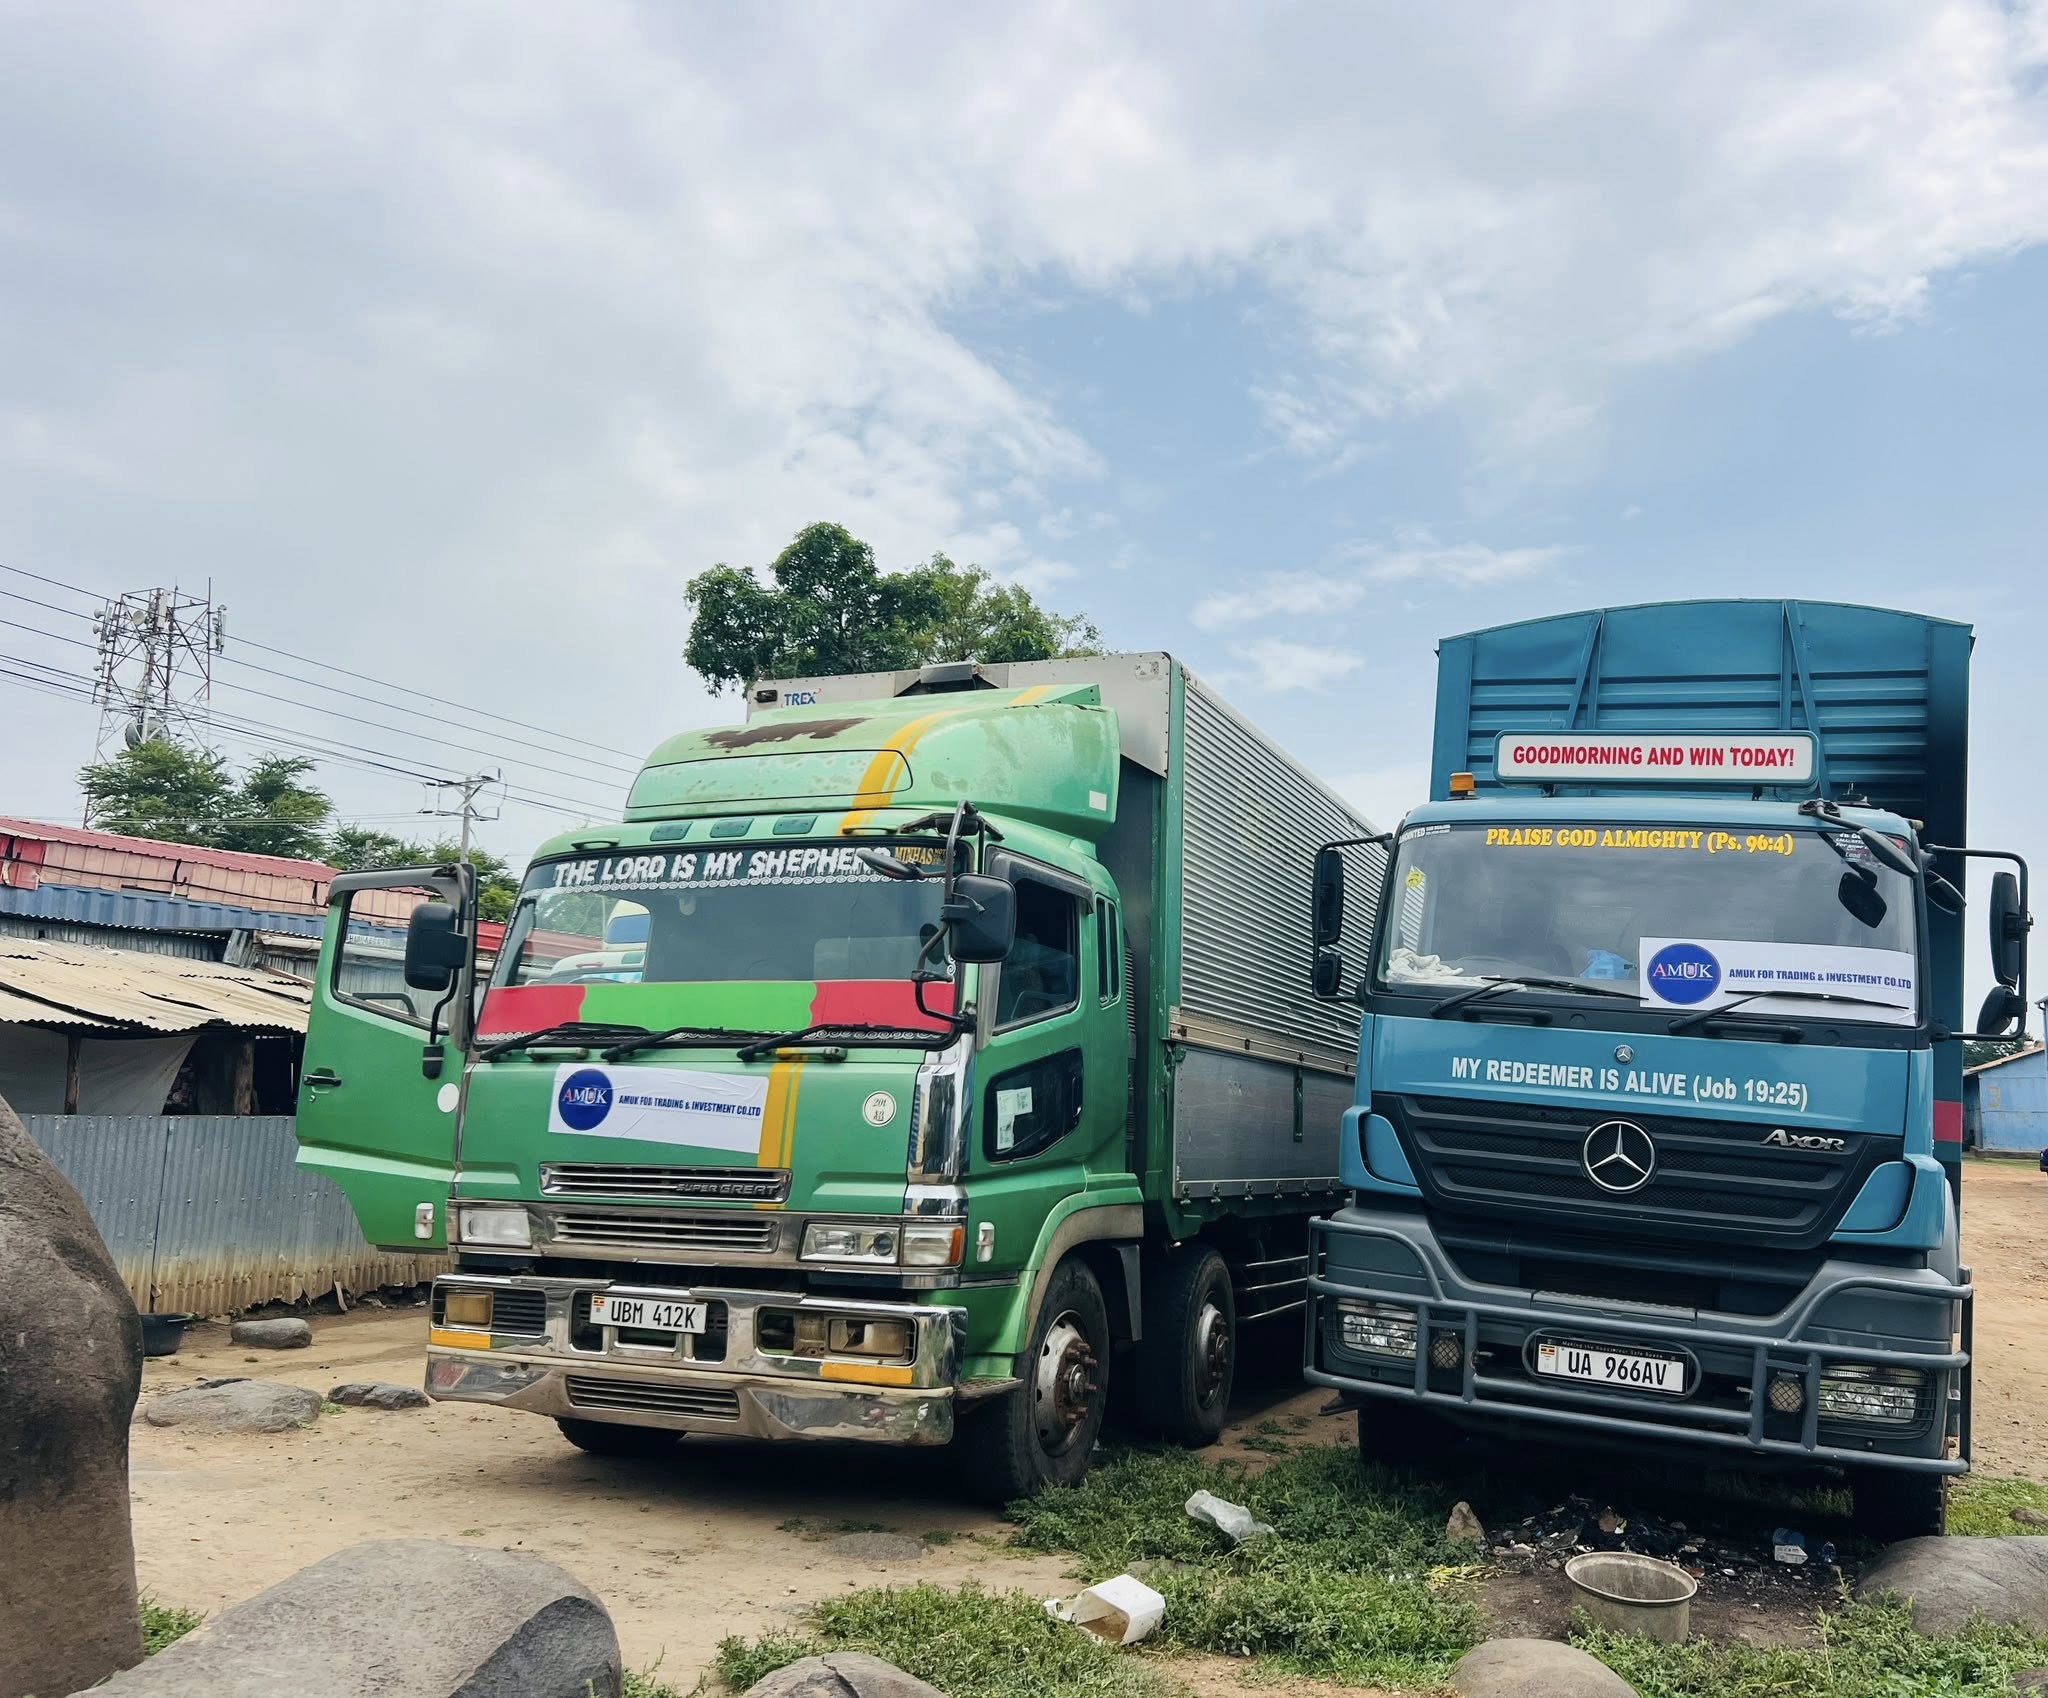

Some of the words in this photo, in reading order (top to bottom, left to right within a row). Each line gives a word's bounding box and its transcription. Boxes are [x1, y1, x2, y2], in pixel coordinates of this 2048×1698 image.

[784, 692, 817, 706] TREX
[1513, 746, 1642, 766] GOODMORNING
[1647, 747, 1683, 766] AND
[1689, 747, 1724, 767] WIN
[1730, 747, 1795, 767] TODAY!
[1486, 828, 1553, 846] PRAISE
[1557, 829, 1597, 847] GOD
[1600, 829, 1704, 849] ALMIGHTY
[1707, 832, 1742, 854] (Ps.
[1746, 833, 1794, 856] 96:4)
[553, 859, 599, 888] THE
[601, 855, 667, 884] LORD
[671, 853, 698, 881] IS
[703, 851, 744, 880] MY
[1652, 962, 1714, 979] AMUK
[1729, 969, 1756, 979] AMUK
[1758, 970, 1774, 979] FOR
[1776, 970, 1816, 981] TRADING
[1818, 973, 1825, 981] &
[1826, 972, 1883, 985] INVESTMENT
[1452, 1057, 1481, 1079] MY
[1486, 1059, 1594, 1090] REDEEMER
[1600, 1069, 1619, 1090] IS
[1624, 1070, 1687, 1096] ALIVE
[1693, 1075, 1738, 1103] (Job
[1744, 1079, 1809, 1113] 19:25)
[561, 1087, 608, 1105] AMUK
[619, 1095, 639, 1105] AMUK
[655, 1097, 684, 1109] TRADING
[685, 1102, 690, 1110] &
[692, 1101, 737, 1114] INVESTMENT
[676, 1183, 718, 1193] SUPER
[720, 1184, 780, 1195] GREAT
[610, 1300, 643, 1324] UBM
[652, 1304, 696, 1329] 412K
[1568, 1351, 1592, 1376] UA
[1605, 1356, 1667, 1386] 966AV
